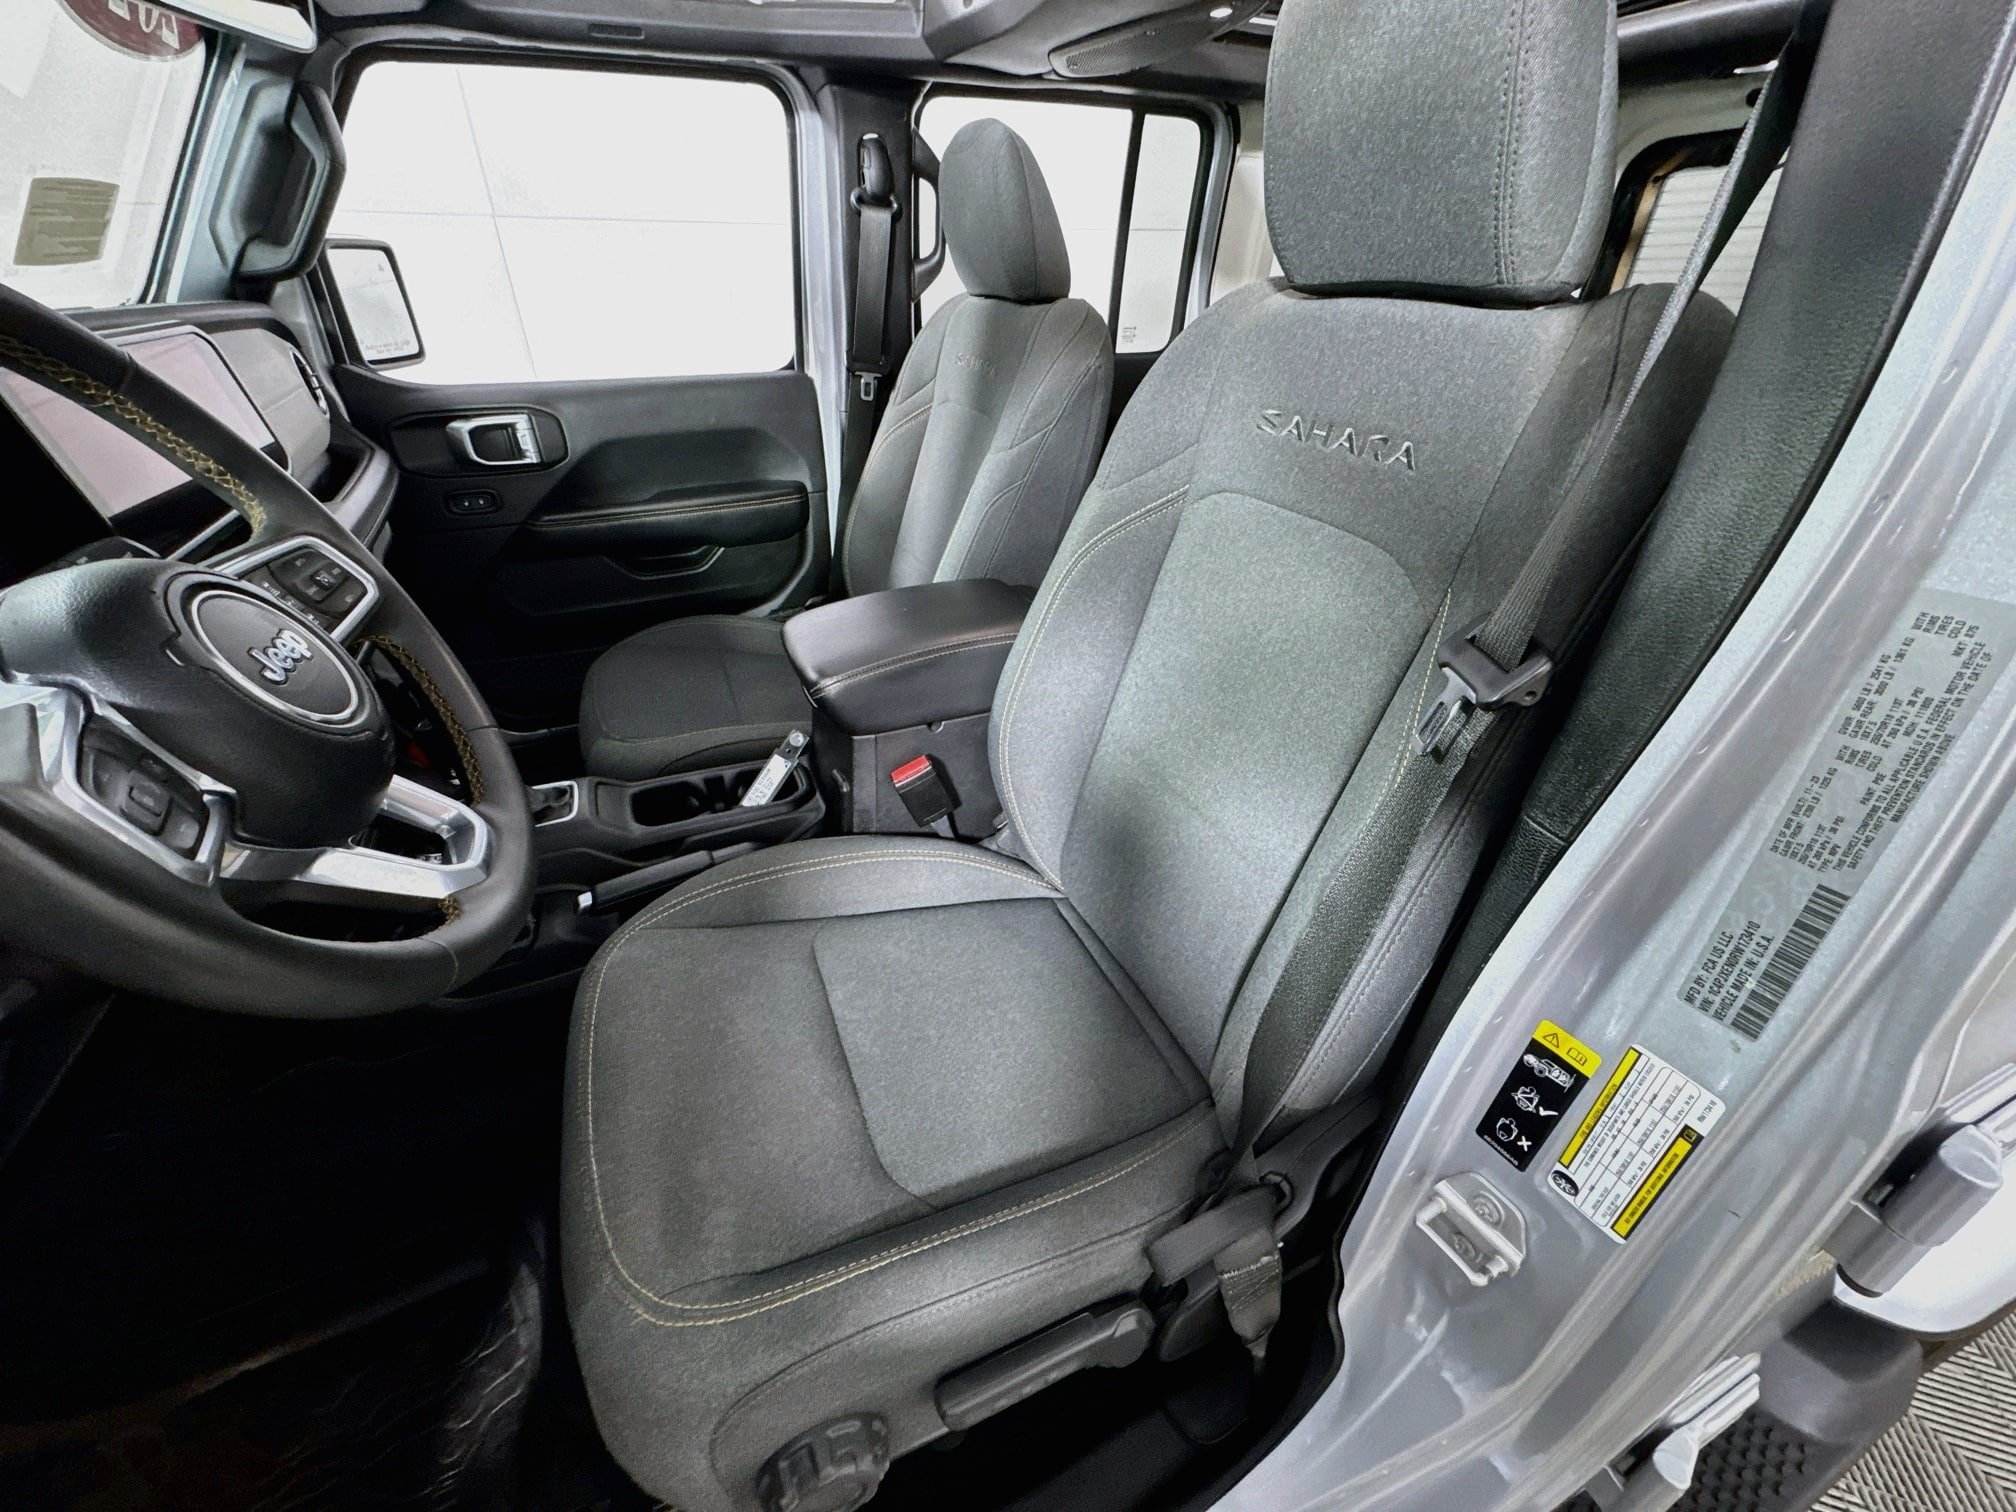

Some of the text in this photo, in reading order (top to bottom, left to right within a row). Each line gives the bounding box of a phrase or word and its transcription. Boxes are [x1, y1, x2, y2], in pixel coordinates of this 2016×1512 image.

[1256, 408, 1416, 472] SAHARA
[1911, 612, 1931, 630] WITH
[1922, 616, 1942, 633] RIMS
[1934, 616, 1956, 636] TIRES
[1946, 621, 1967, 638] COLD
[1902, 638, 1915, 646] KG
[247, 629, 314, 685] Jeep
[1959, 643, 1987, 670] VEHICLE
[1860, 688, 1872, 696] LB
[1878, 655, 1892, 664] KG
[1967, 663, 1987, 681] DATE
[1944, 672, 1968, 694] MOTOR
[1957, 683, 1975, 696] THE
[1911, 688, 1926, 698] PSI
[1925, 696, 1952, 725] FEDERAL
[1950, 698, 1965, 707] ON
[1934, 709, 1958, 732] EFFECT
[1835, 746, 1851, 761] WITH
[1855, 751, 1873, 768] TIRES
[1904, 742, 1936, 779] STANDARDS
[1826, 768, 1838, 776] KG
[1866, 756, 1883, 771] COLD
[1888, 747, 1920, 782] APPLICABLE
[1890, 734, 1956, 824] MANUFACTURE SHOWN ABOVE
[1881, 783, 1896, 795] ALL
[1881, 779, 1912, 816] PREVENTION
[1875, 796, 1888, 804] TO
[1856, 805, 1883, 836] CONFORMS
[1869, 817, 1887, 835] THEFT
[1769, 839, 1784, 852] DATE
[1841, 836, 1862, 858] VEHICLE
[1861, 835, 1876, 848] AND
[1833, 859, 1847, 871] THIS
[1847, 849, 1866, 869] SAFETY
[1684, 931, 1734, 1004] MFD BY: FCA US LLC
[1712, 932, 1775, 1022] VEHICLE MADE IN: U.S.A.
[1698, 996, 1715, 1013] VIN:
